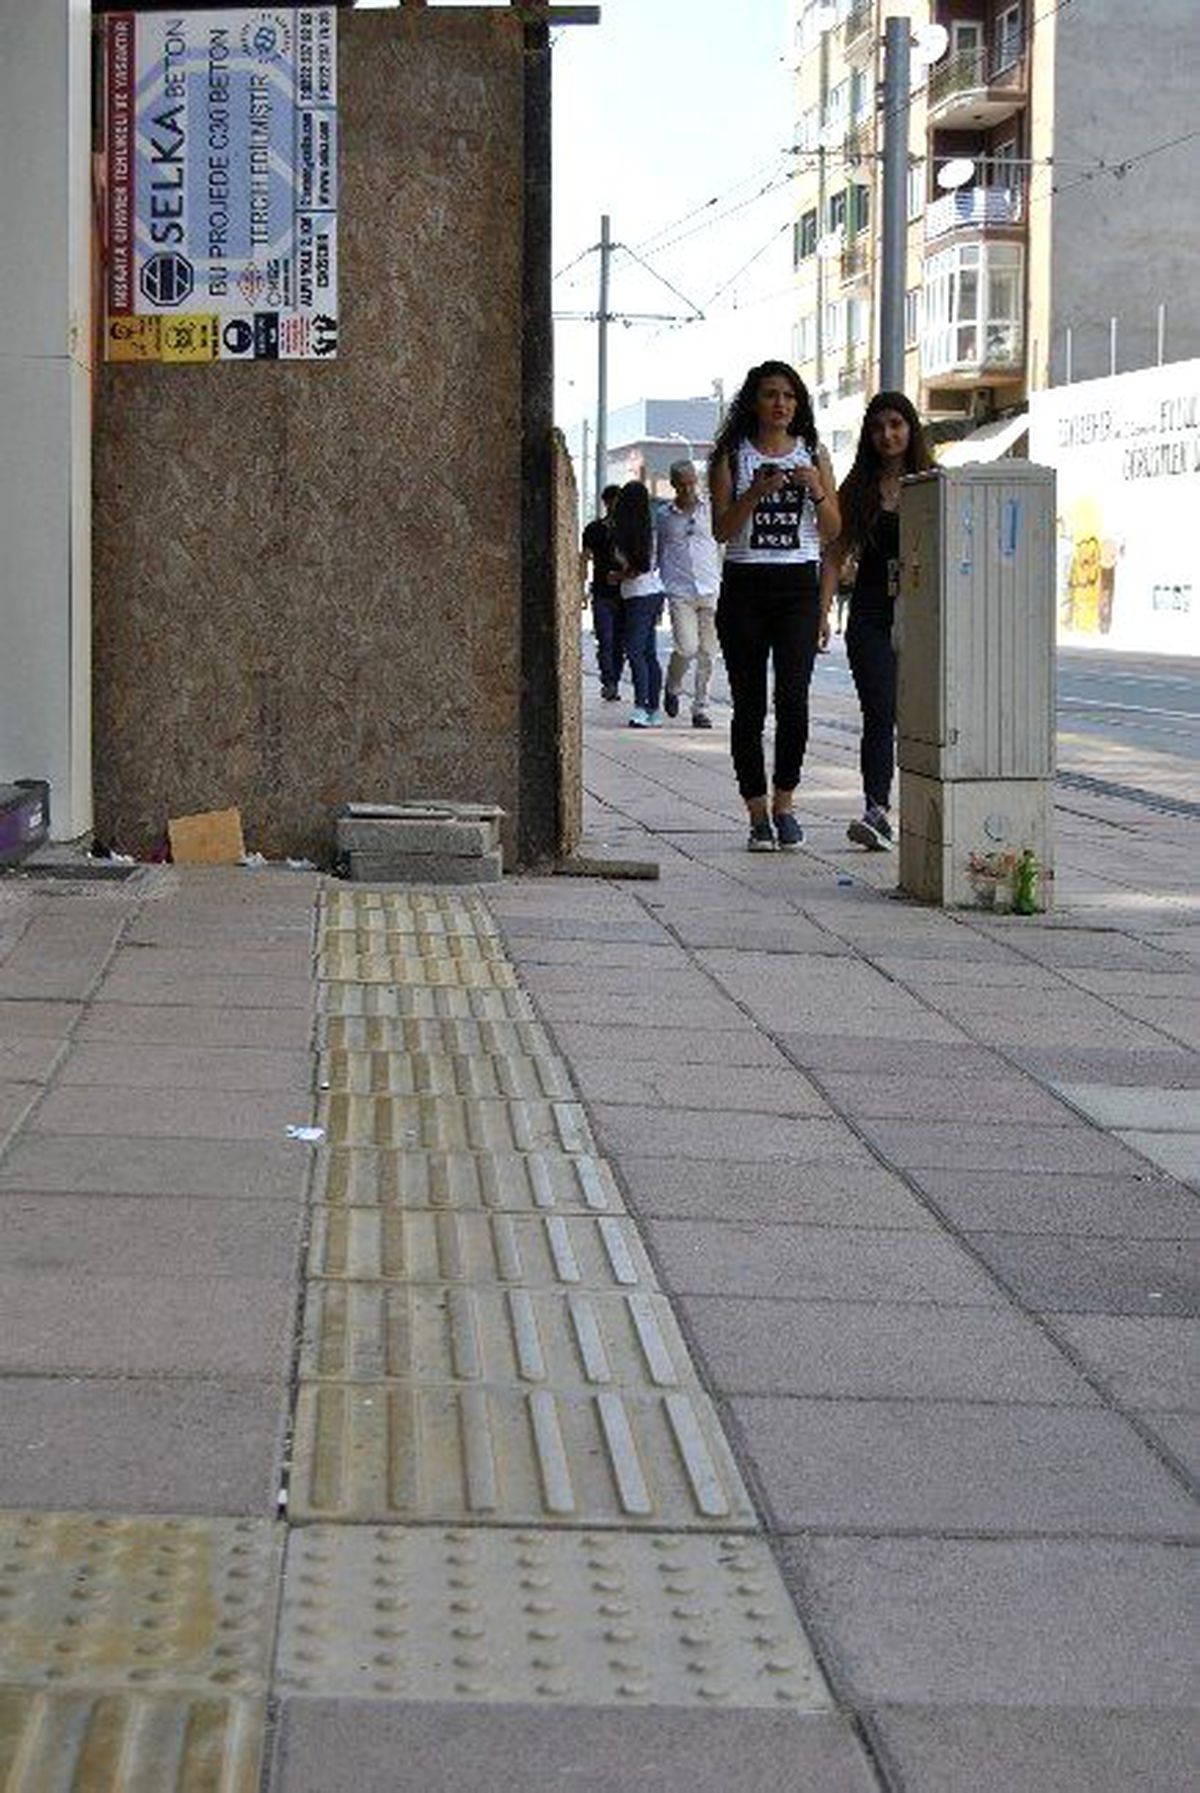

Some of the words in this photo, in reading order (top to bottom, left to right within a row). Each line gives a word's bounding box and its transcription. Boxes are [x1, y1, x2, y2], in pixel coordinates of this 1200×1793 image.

[164, 20, 185, 98] BETON
[208, 29, 229, 104] BETON
[208, 110, 228, 150] C30
[150, 104, 184, 244] SELKA
[208, 156, 228, 258] PROJEDE
[208, 267, 228, 296] BU
